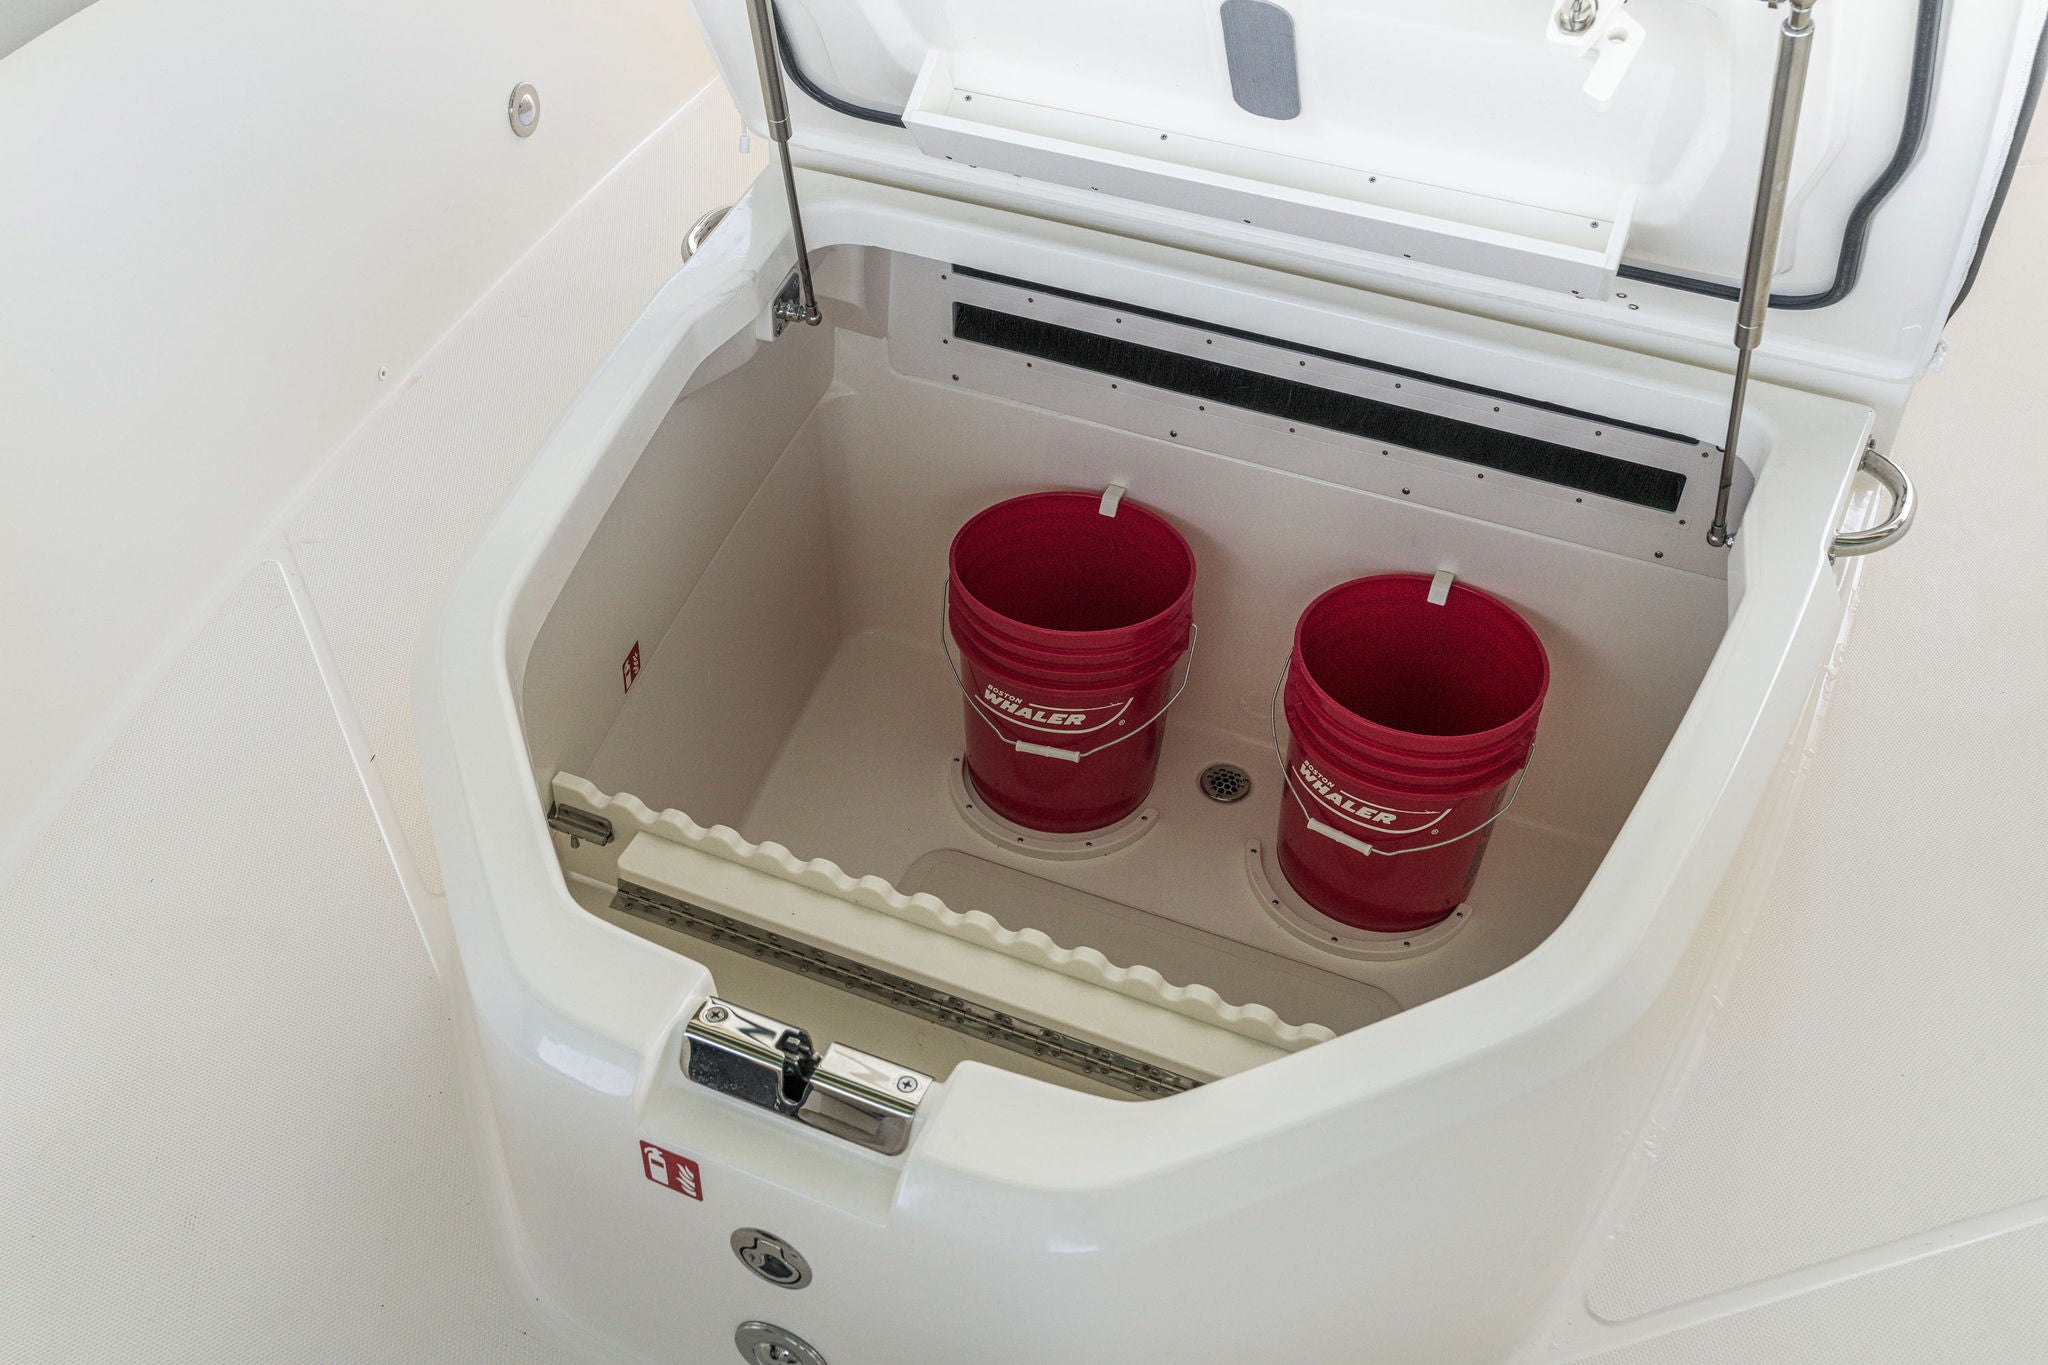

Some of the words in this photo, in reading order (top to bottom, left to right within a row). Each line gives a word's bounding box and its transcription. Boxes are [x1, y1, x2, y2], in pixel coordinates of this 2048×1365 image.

[984, 688, 1086, 726] WHALER
[987, 684, 1023, 704] BOSTON
[1303, 759, 1335, 788] BOSTON
[1300, 763, 1397, 825] WHALER
